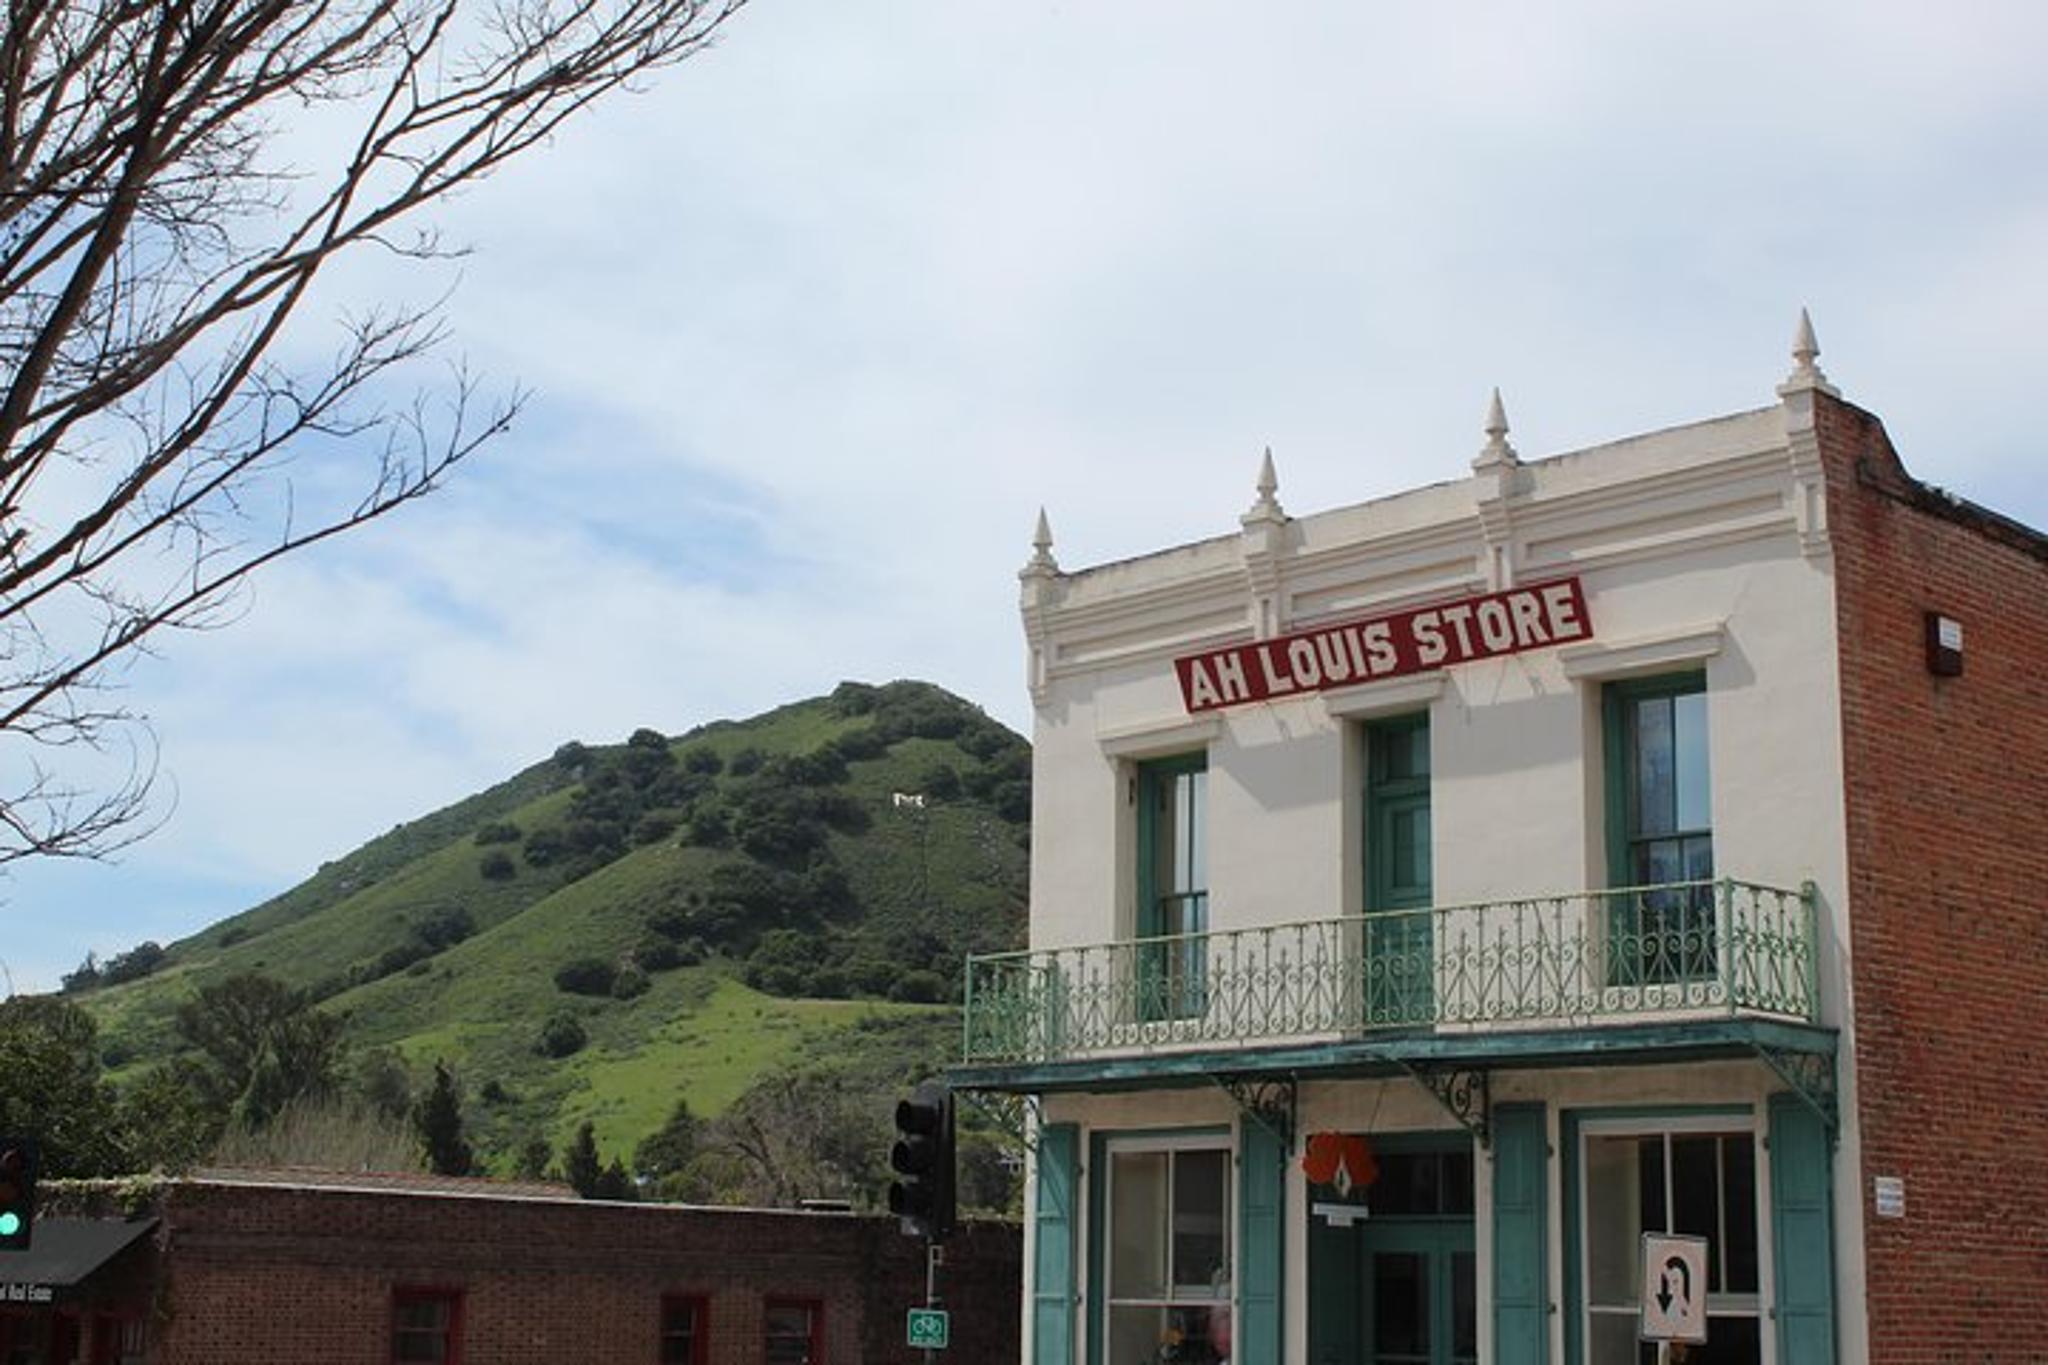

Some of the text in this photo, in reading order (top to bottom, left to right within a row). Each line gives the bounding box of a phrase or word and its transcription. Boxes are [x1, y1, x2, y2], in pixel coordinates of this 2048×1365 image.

[1189, 584, 1582, 709] AH LOUIS STORE
